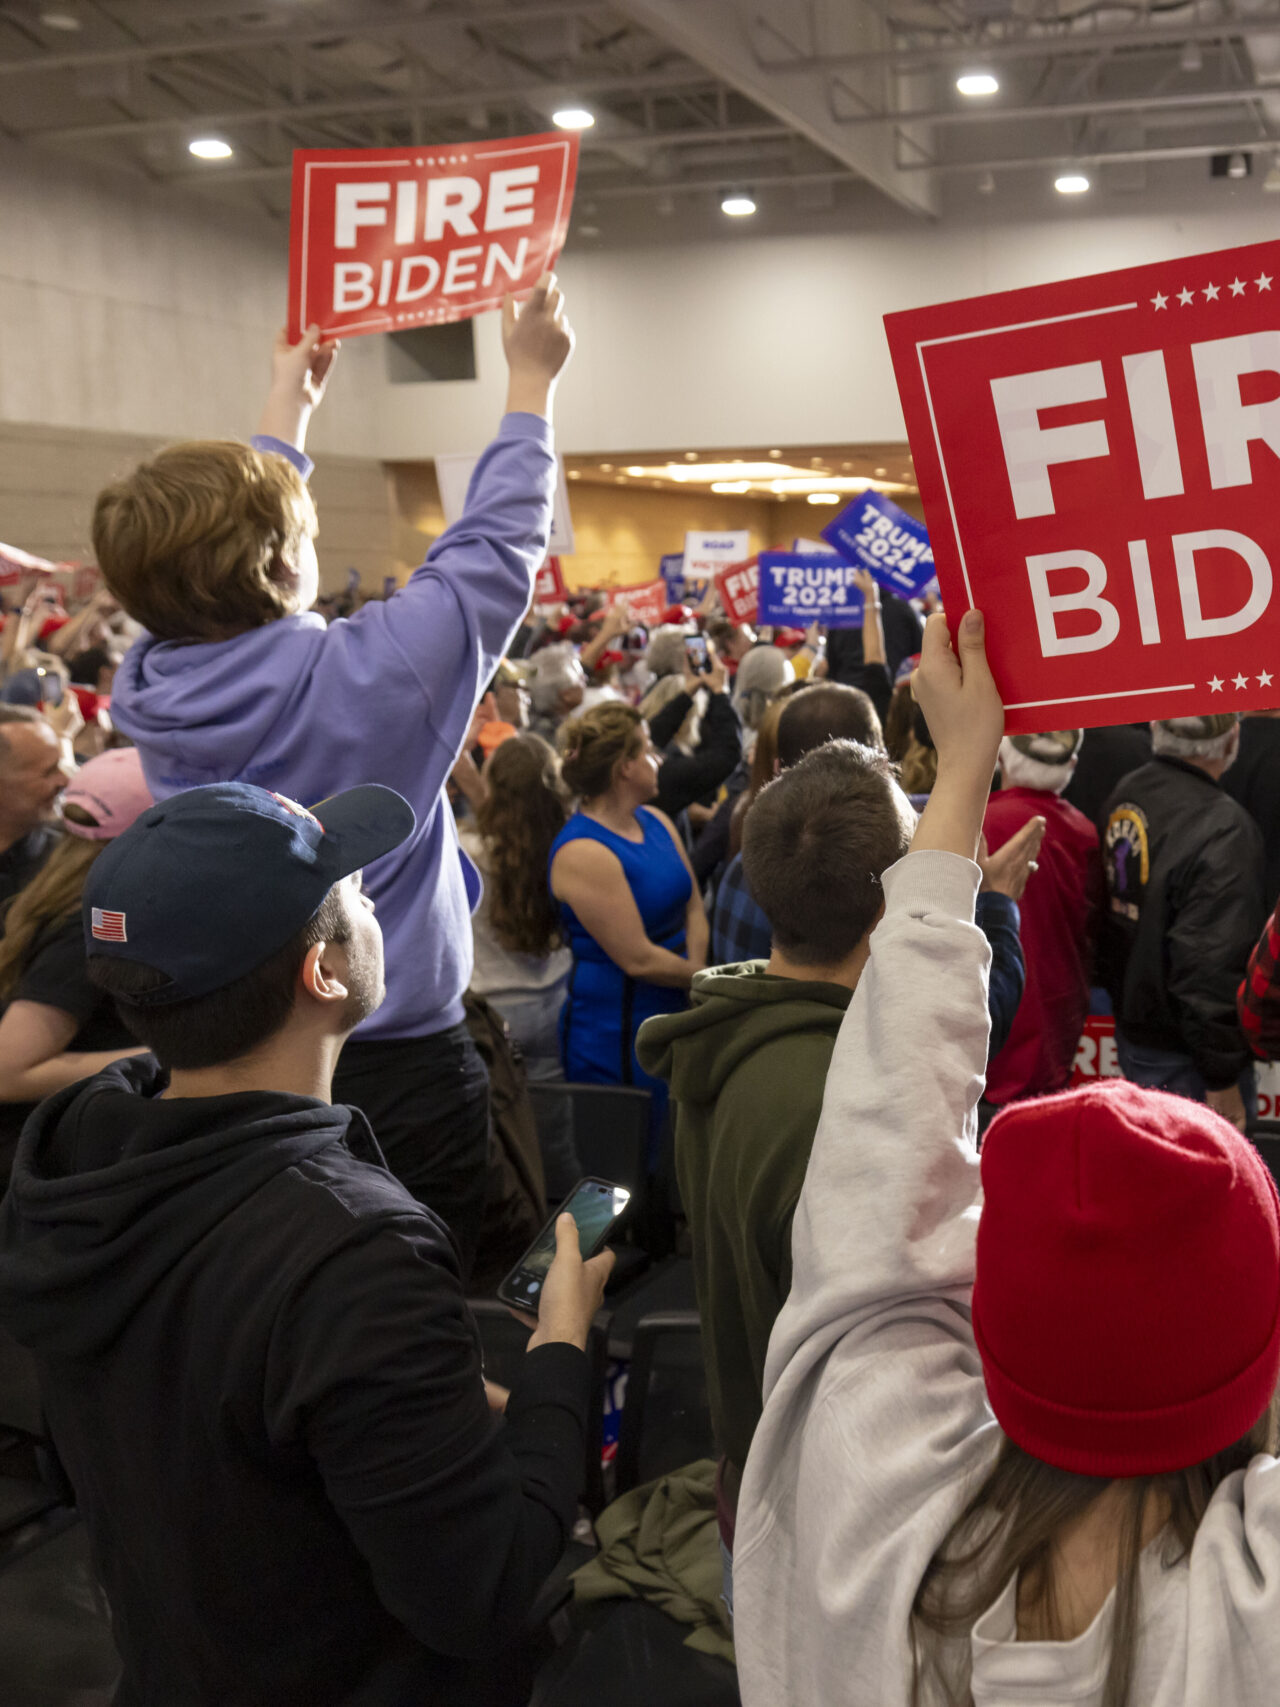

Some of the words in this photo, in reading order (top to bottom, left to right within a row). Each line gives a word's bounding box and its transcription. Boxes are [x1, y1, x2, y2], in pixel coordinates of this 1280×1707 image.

[335, 165, 539, 249] FIRE
[333, 237, 529, 313] BIDEN
[855, 526, 916, 574] 2024
[782, 585, 846, 606] 2024
[1071, 1036, 1122, 1076] RE
